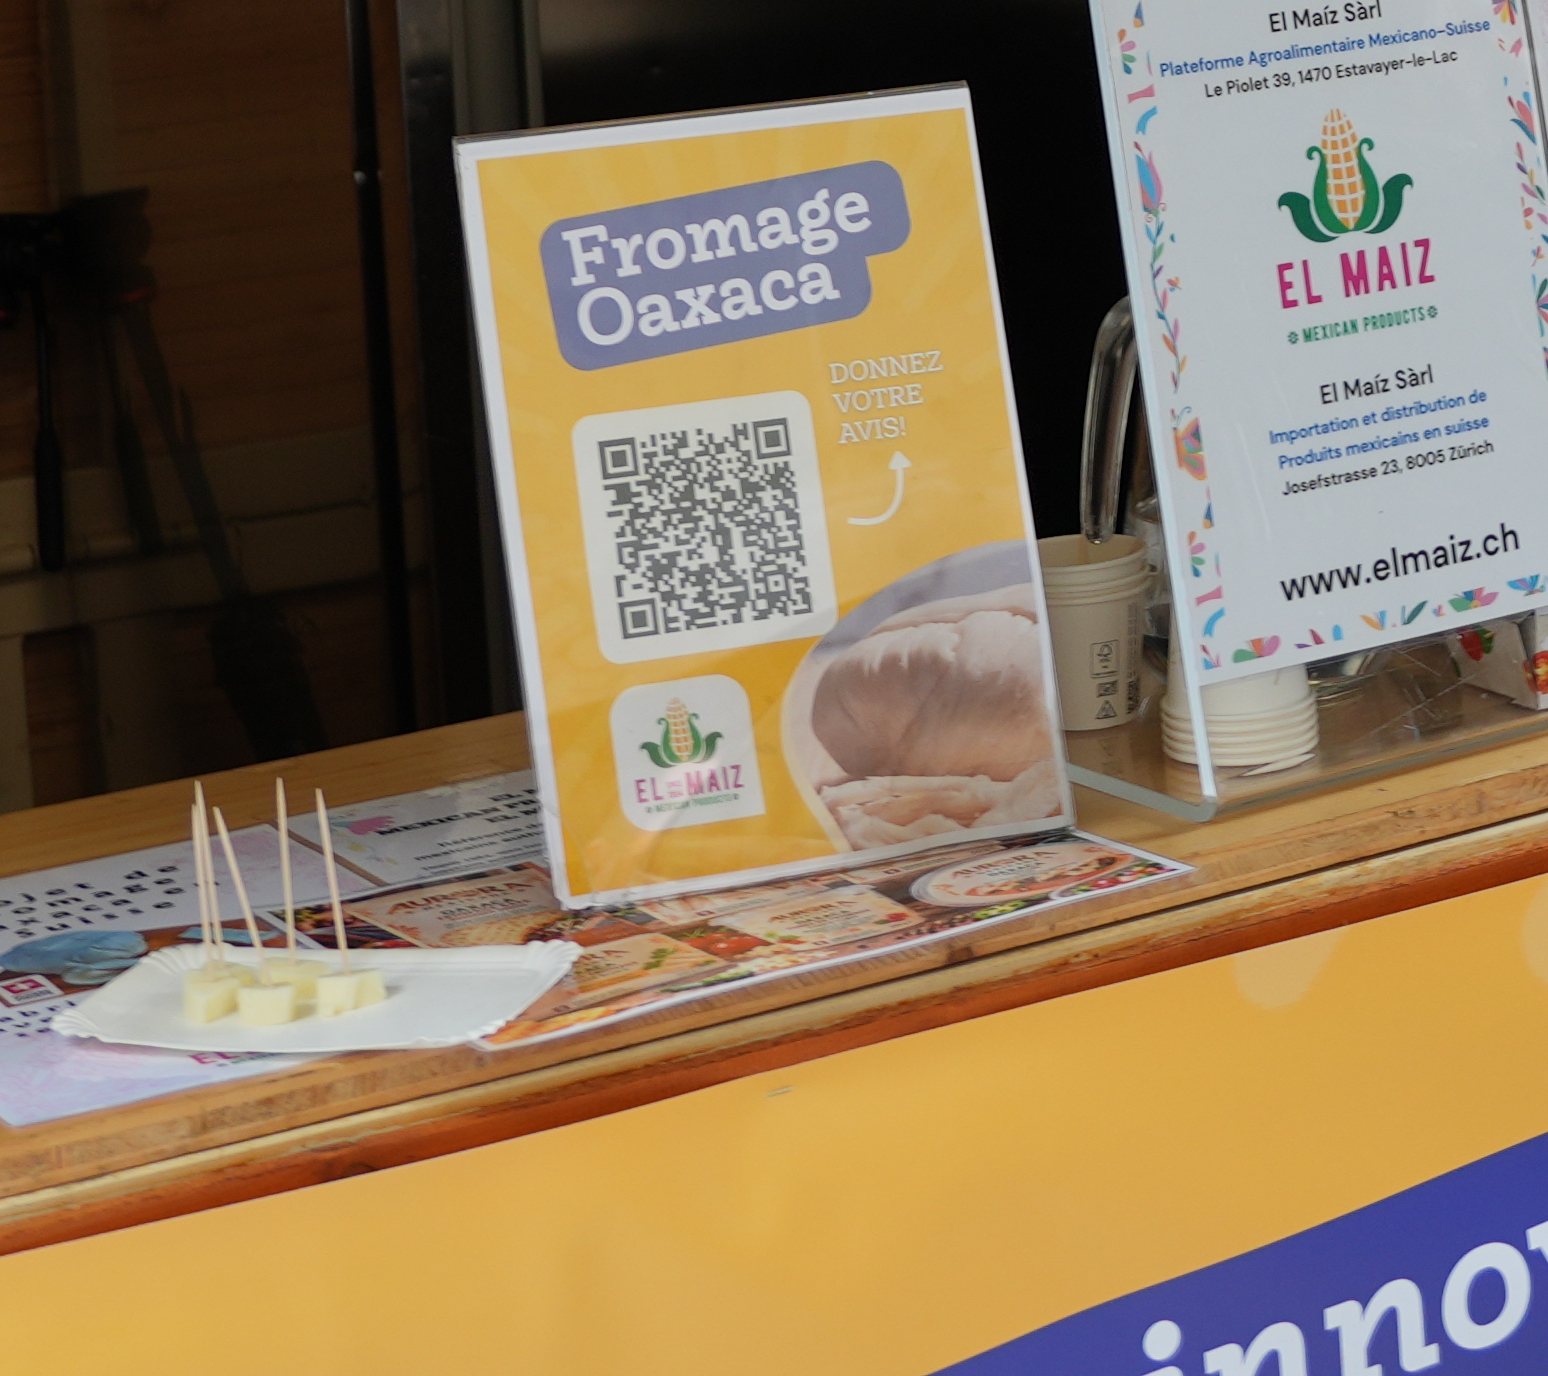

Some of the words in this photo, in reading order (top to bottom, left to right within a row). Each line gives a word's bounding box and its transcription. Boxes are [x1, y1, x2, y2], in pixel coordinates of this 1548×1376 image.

[1269, 11, 1287, 33] El
[1292, 5, 1339, 29] Maíz
[1159, 56, 1244, 77] Plateforme
[1248, 37, 1366, 68] Agroalimentaire
[1368, 20, 1490, 48] Mexicano–Suisse
[1204, 84, 1223, 98] Le
[1226, 76, 1270, 95] Piolet
[1272, 72, 1295, 88] 39,
[1297, 66, 1332, 84] 1470
[1335, 50, 1458, 79] Estavayer-le-Lac
[560, 187, 873, 287] Fromage
[1277, 259, 1323, 309] EL
[1339, 238, 1436, 298] MAIZ
[576, 261, 841, 346] Oaxaca
[1303, 318, 1359, 343] MEXICAN
[1362, 306, 1431, 332] PRODUCTS
[828, 349, 945, 385] DONNEZ
[1319, 382, 1339, 405] El
[1343, 374, 1391, 400] Maíz
[1394, 364, 1434, 390] Sàrl
[831, 383, 925, 413] VOTRE
[1269, 417, 1359, 445] Importation
[1361, 411, 1378, 426] et
[1380, 395, 1466, 422] distribution
[1468, 389, 1487, 404] de
[837, 415, 908, 445] AVIS!
[1278, 446, 1343, 470] Produits
[1345, 431, 1421, 456] mexicains
[1422, 427, 1442, 440] en
[1444, 417, 1490, 436] suisse
[1282, 467, 1378, 496] Josefstrasse
[1380, 459, 1403, 476] 23,
[1405, 449, 1446, 470] 8005
[1448, 439, 1494, 461] Zürich
[1279, 522, 1520, 601] www.elmaiz.ch
[633, 776, 665, 804] EL
[683, 764, 745, 797] MAIZ
